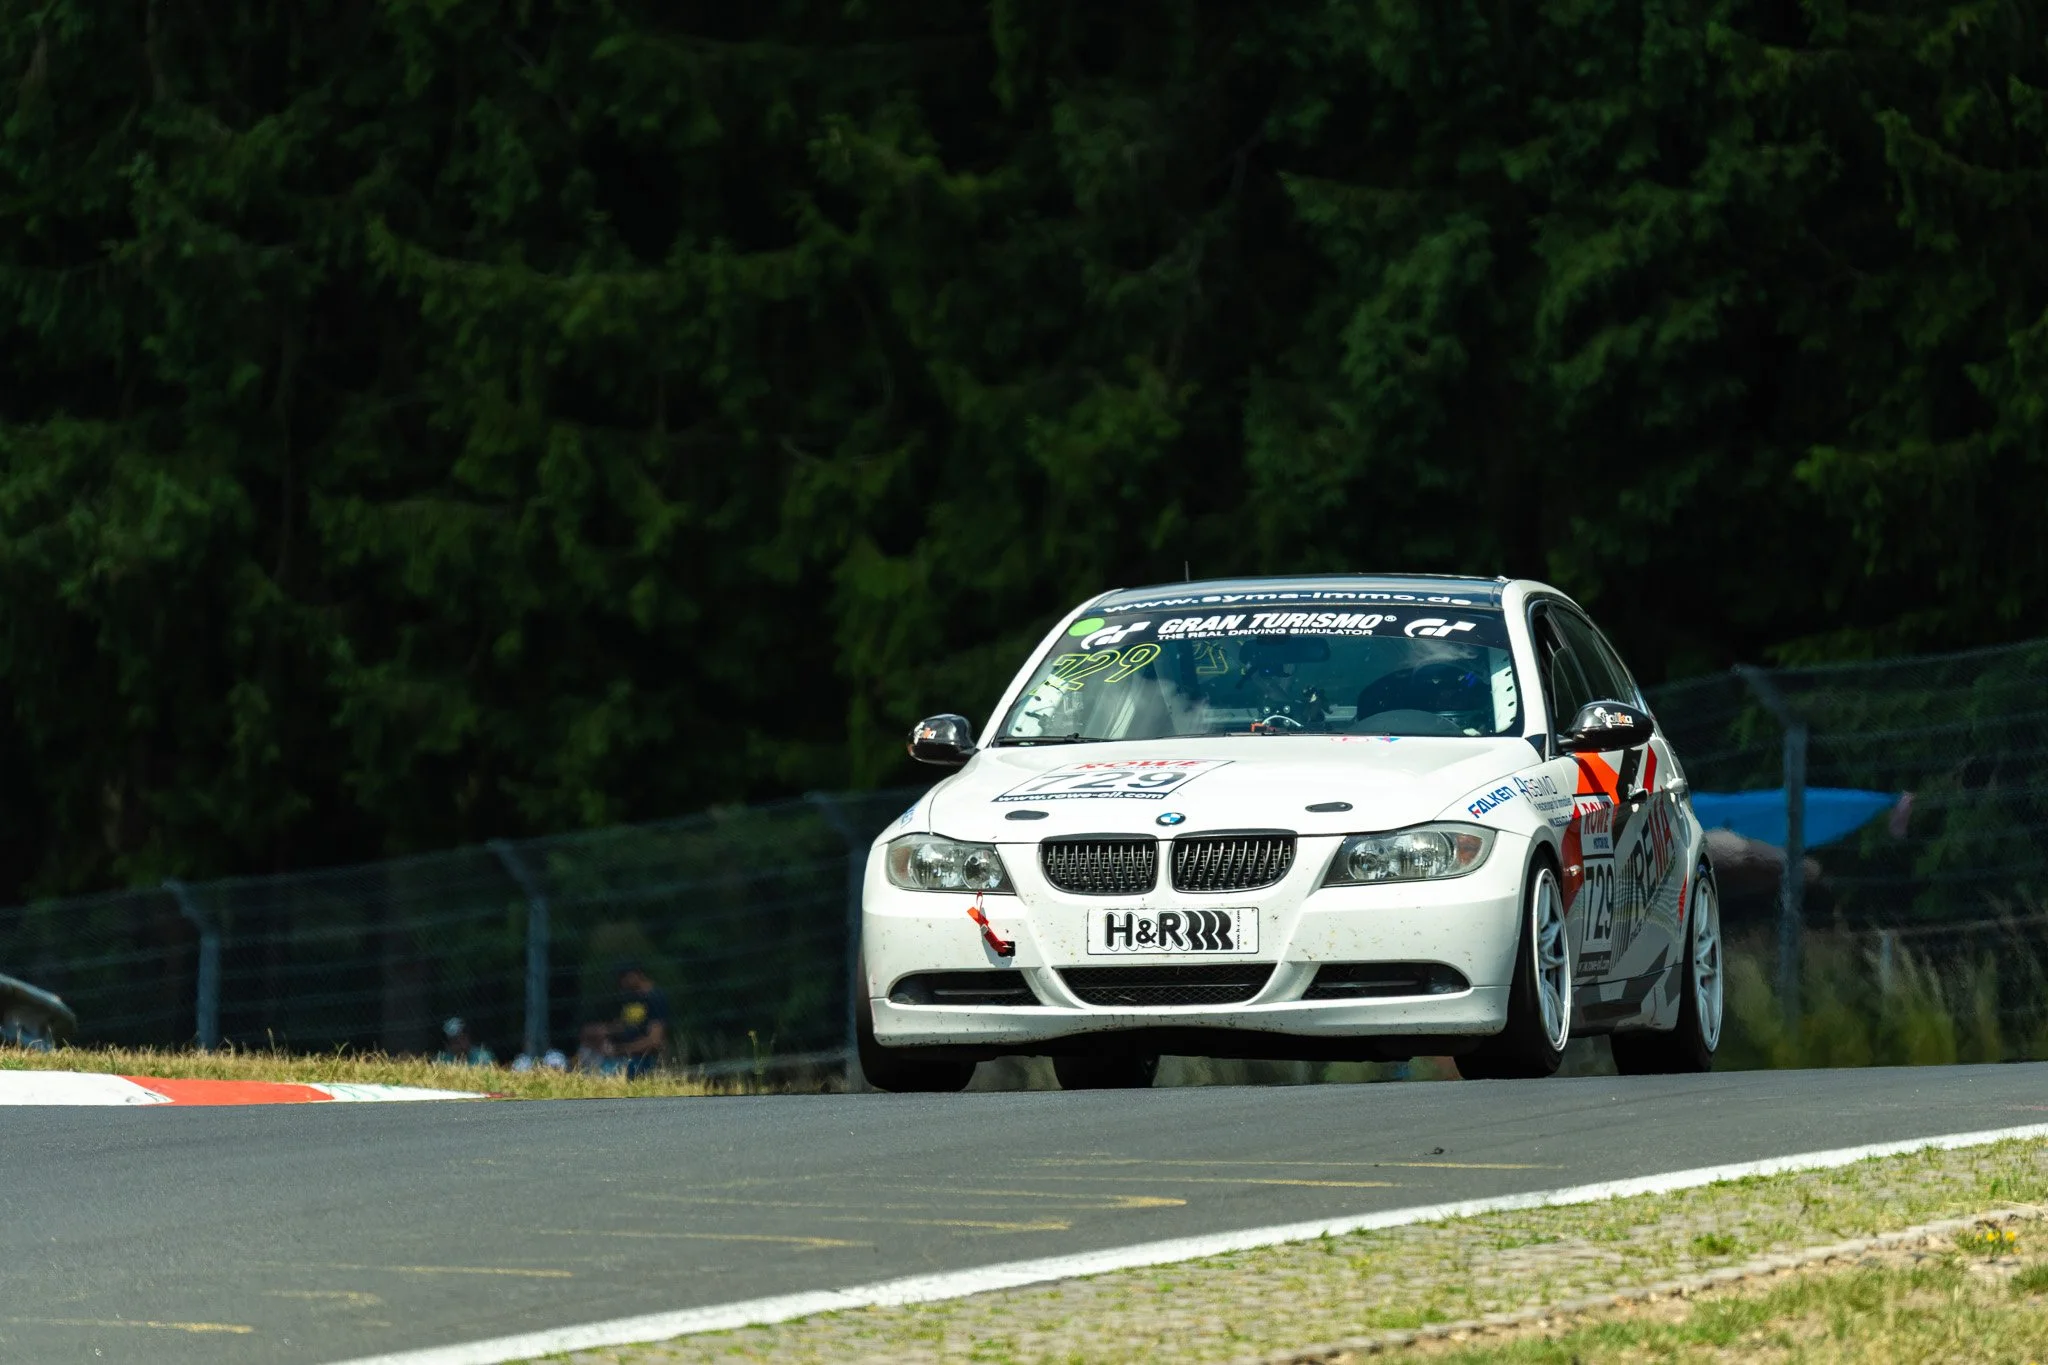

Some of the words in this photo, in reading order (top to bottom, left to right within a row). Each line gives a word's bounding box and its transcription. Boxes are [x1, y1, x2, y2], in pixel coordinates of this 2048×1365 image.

[1157, 614, 1246, 634] GRAN
[1157, 633, 1184, 641] THE
[1188, 630, 1221, 639] REAL
[1227, 627, 1286, 637] DRIVING
[1289, 627, 1373, 636] SIMULATOR
[1030, 643, 1162, 696] 729
[1075, 760, 1201, 771] ROWE
[1027, 771, 1187, 792] 729
[998, 791, 1167, 803] www.rowe-oil.com
[1467, 785, 1518, 819] FALKEN
[1584, 863, 1615, 942] 729
